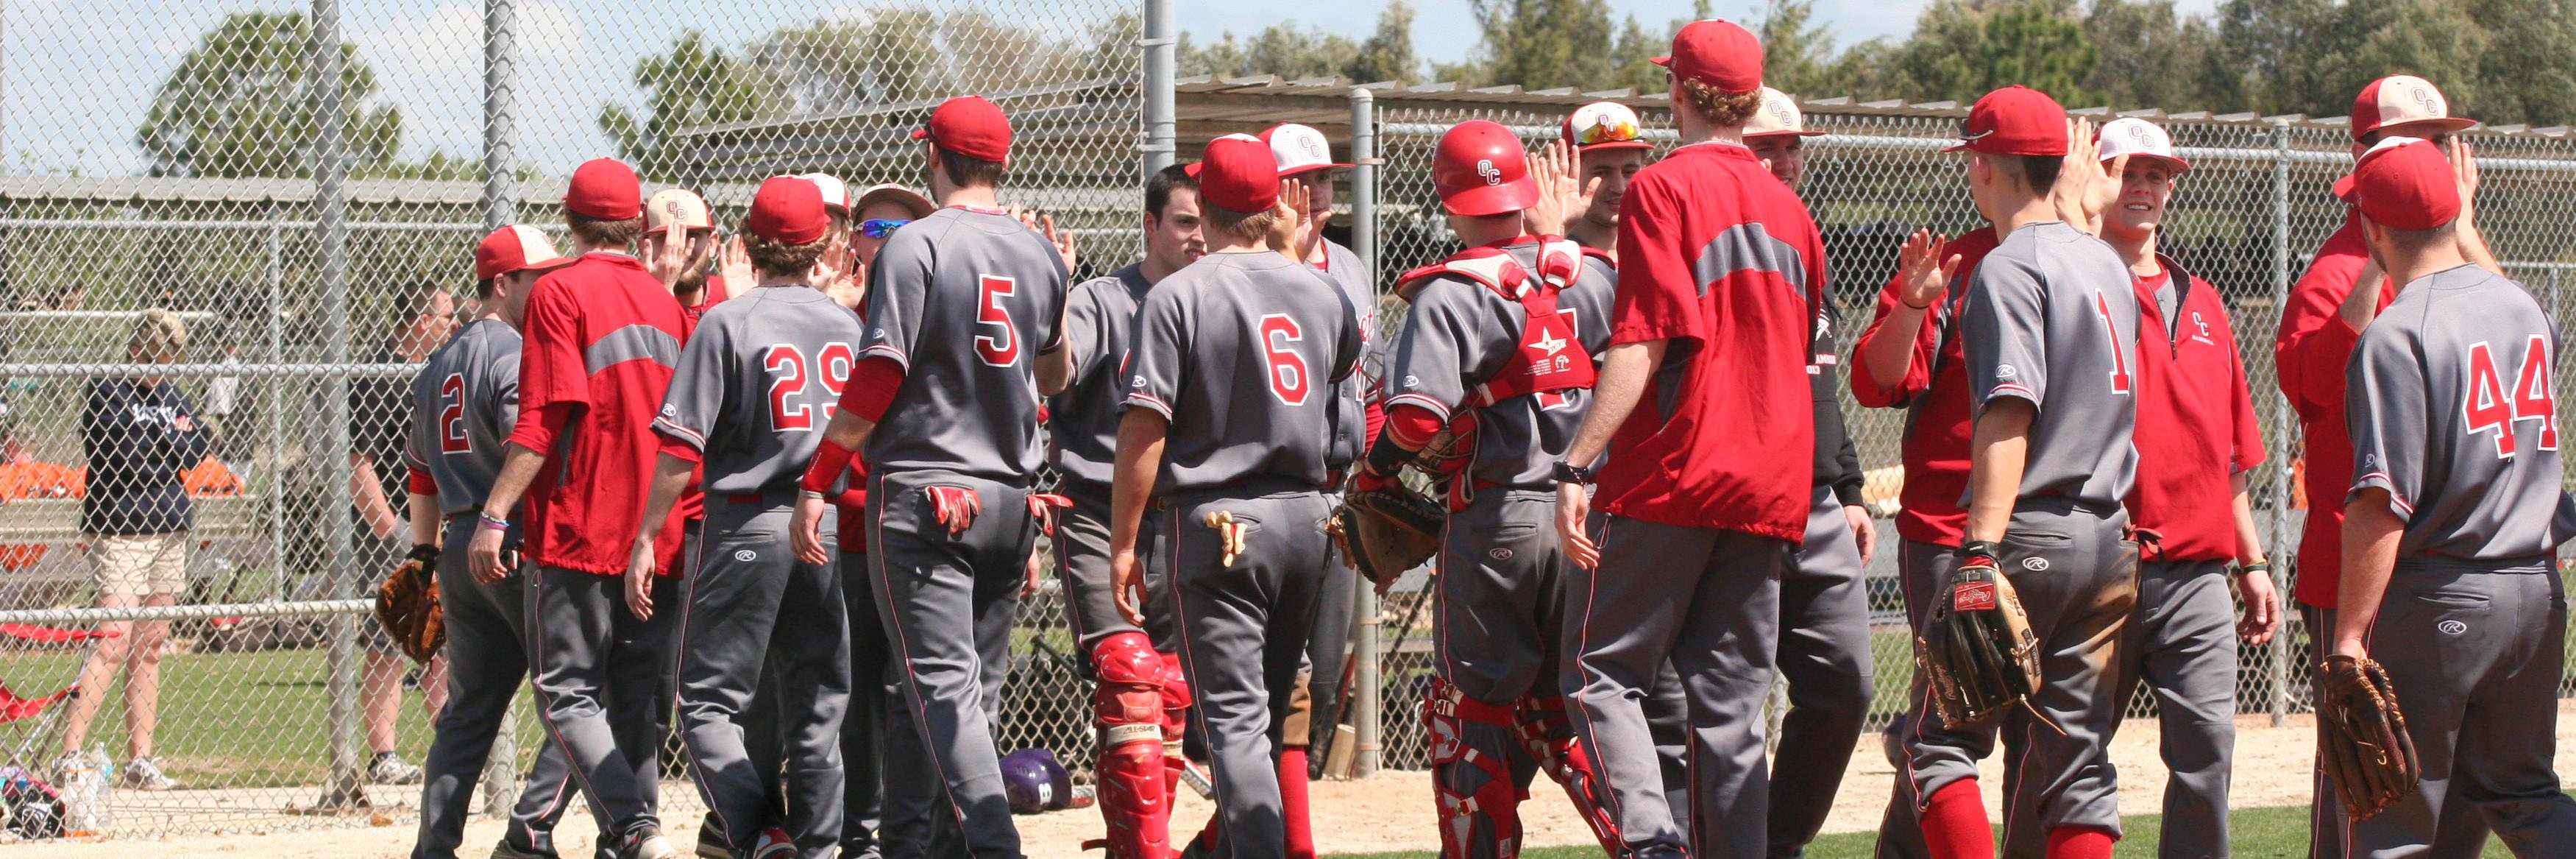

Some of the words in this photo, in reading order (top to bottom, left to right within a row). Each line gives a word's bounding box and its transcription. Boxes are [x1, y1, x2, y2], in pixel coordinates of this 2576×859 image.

[1766, 100, 1792, 126] OC
[2410, 87, 2438, 116] OC
[1297, 135, 1322, 159] OC
[2128, 124, 2154, 149] OC
[1477, 159, 1500, 185] OC
[667, 200, 688, 221] OC
[973, 273, 1021, 367] 5
[2095, 287, 2130, 396] 1
[763, 342, 855, 432] 29
[1257, 313, 1310, 406] 6
[440, 372, 472, 454] 2
[2462, 333, 2558, 459] 44
